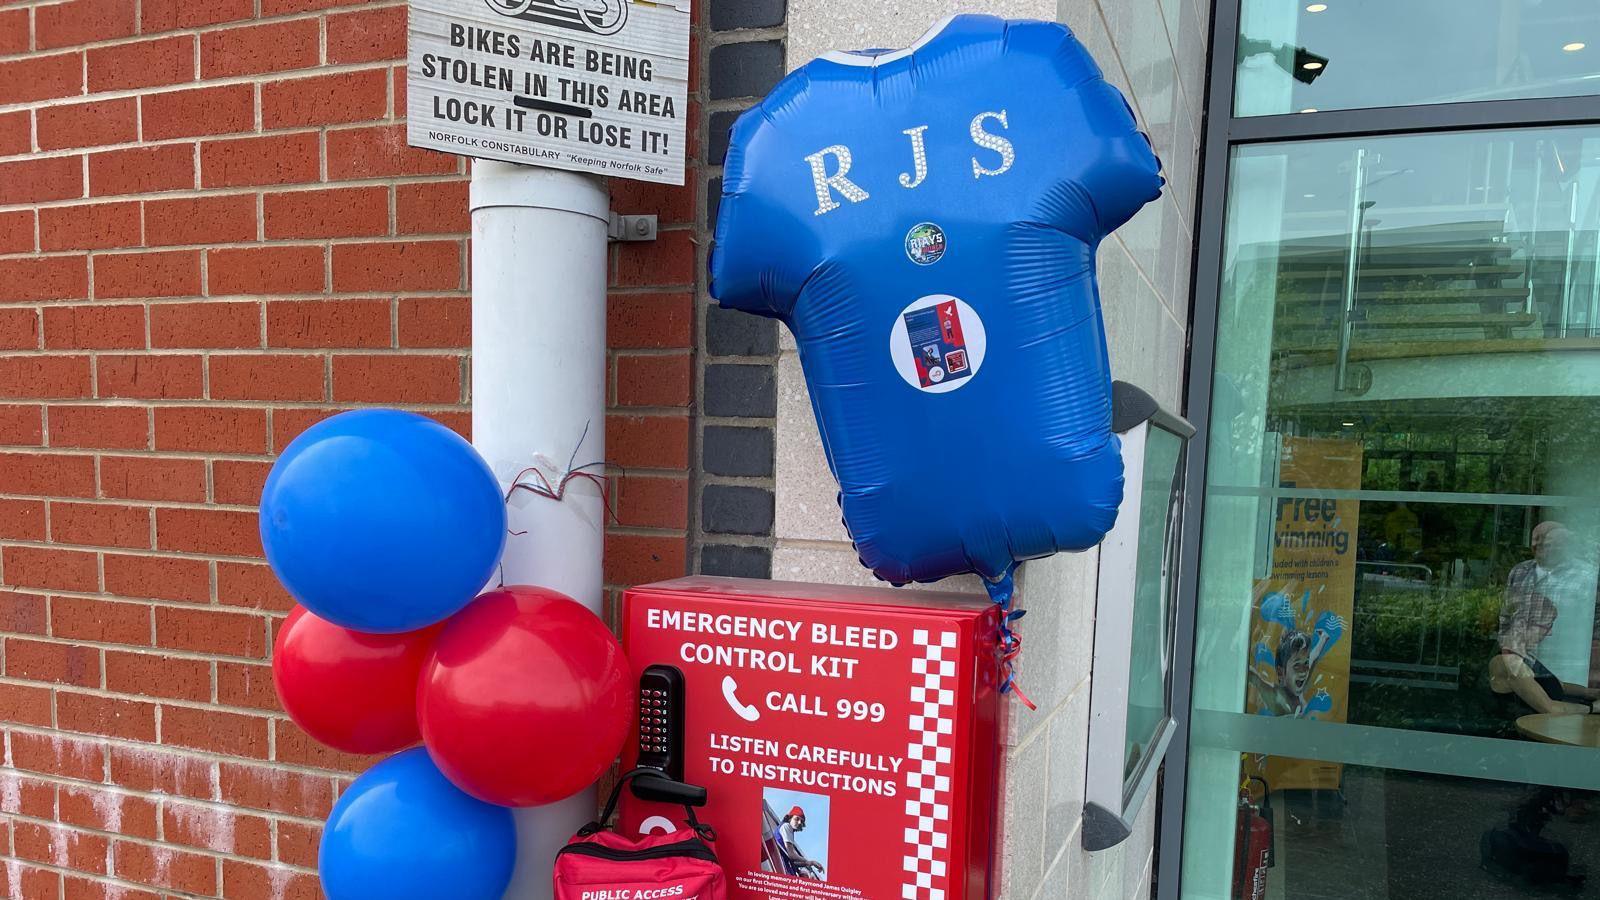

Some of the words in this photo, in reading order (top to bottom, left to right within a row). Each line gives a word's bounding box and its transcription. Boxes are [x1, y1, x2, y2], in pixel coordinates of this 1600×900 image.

[450, 23, 520, 58] BIKES
[530, 39, 575, 68] ARE
[585, 49, 652, 82] BEING
[422, 53, 513, 92] STOLEN
[524, 72, 548, 97] IN
[558, 77, 609, 108] THIS
[618, 90, 675, 118] AREA
[433, 95, 496, 128] LOCK
[505, 108, 527, 132] IT
[536, 113, 568, 139] OR
[578, 120, 632, 149] LOSE
[641, 131, 669, 155] IT!
[428, 131, 479, 147] NORFOLK
[481, 140, 561, 160] CONSTABULARY
[609, 160, 642, 173] Norfolk
[803, 144, 870, 216] R
[898, 125, 929, 188] J
[969, 109, 1016, 179] S
[1276, 481, 1337, 522] Free
[647, 608, 803, 642] EMERGENCY
[811, 624, 898, 651] BLEED
[680, 642, 801, 674] CONTROL
[811, 655, 859, 680] KIT
[765, 691, 828, 717] CALL
[836, 698, 886, 723] 999
[710, 733, 779, 757] LISTEN
[785, 740, 903, 774] CAREFULLY
[709, 756, 735, 774] TO
[740, 760, 897, 797] INSTRUCTIONS
[581, 889, 630, 900] PUBLIC
[633, 885, 684, 900] ACCESS
[770, 874, 791, 883] memory
[799, 880, 823, 889] Raymond
